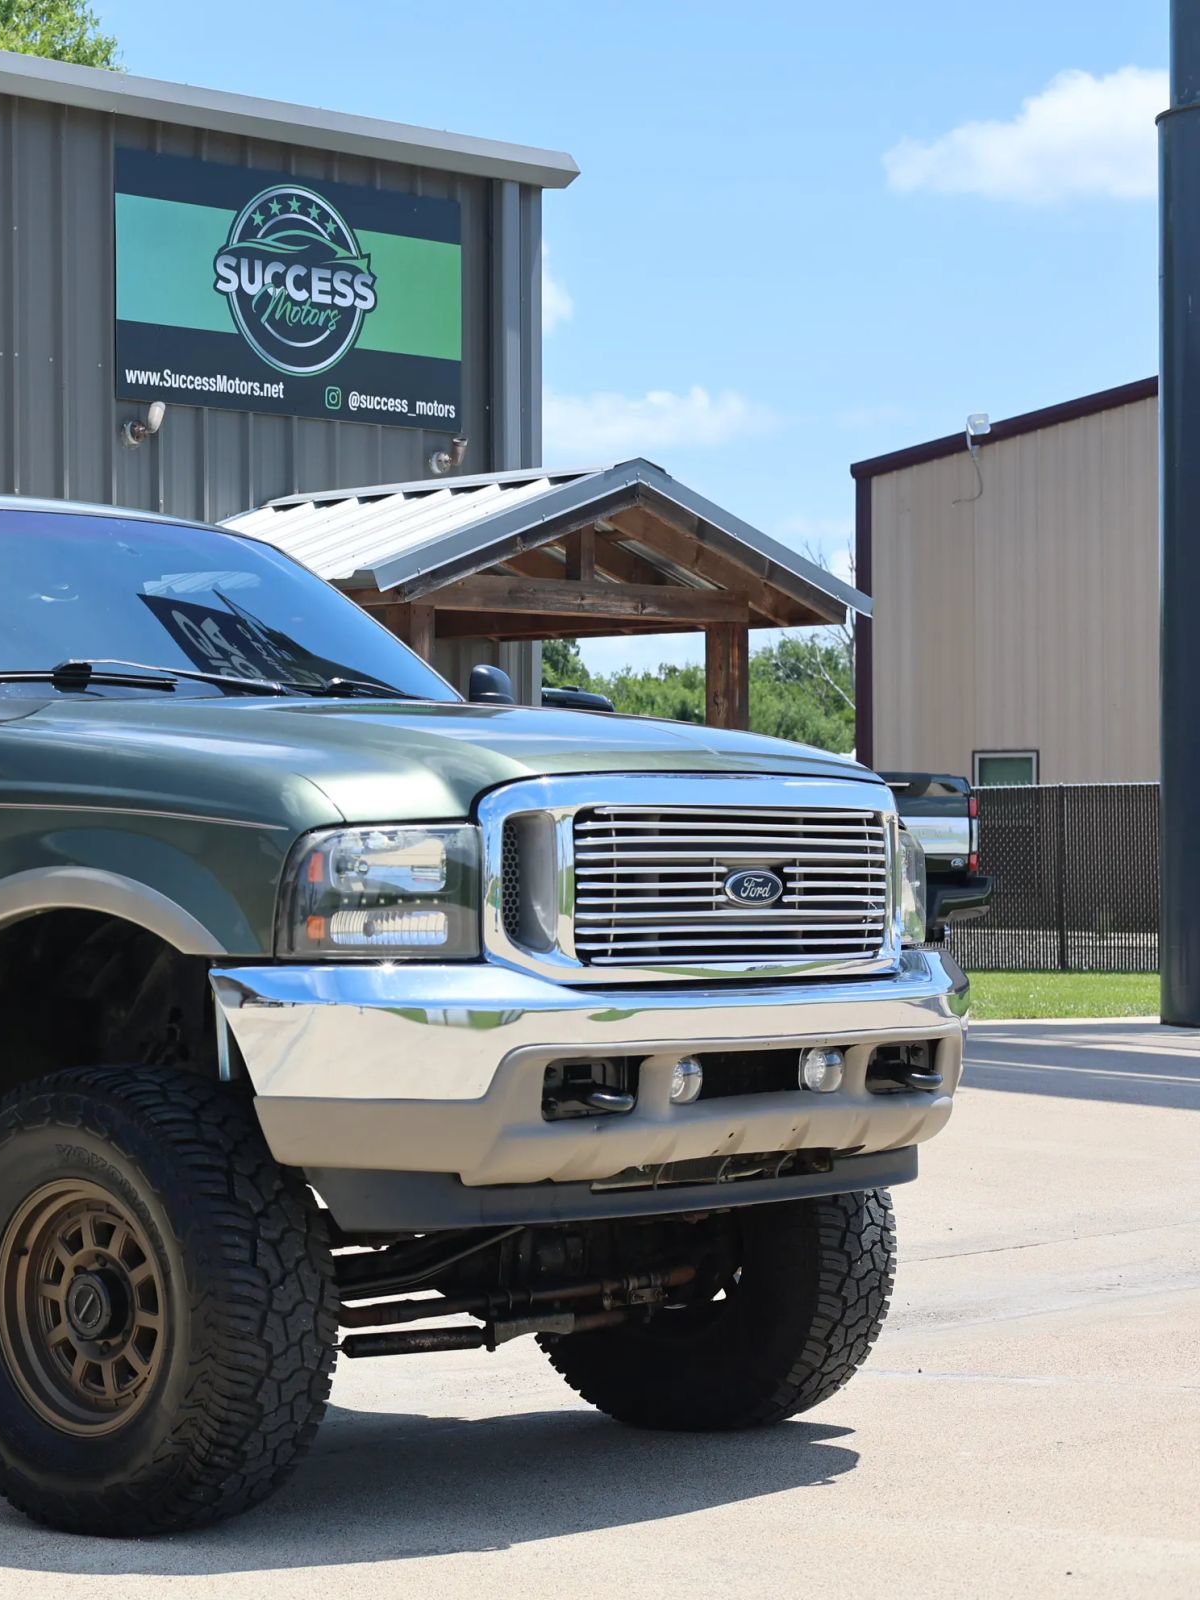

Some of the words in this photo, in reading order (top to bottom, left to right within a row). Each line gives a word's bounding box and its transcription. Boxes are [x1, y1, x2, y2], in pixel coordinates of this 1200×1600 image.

[216, 254, 375, 310] SUCCESS
[251, 282, 341, 331] Motors
[125, 368, 284, 399] www.SuccessMotors.net
[348, 391, 456, 418] @success_motors
[740, 876, 772, 898] Ford
